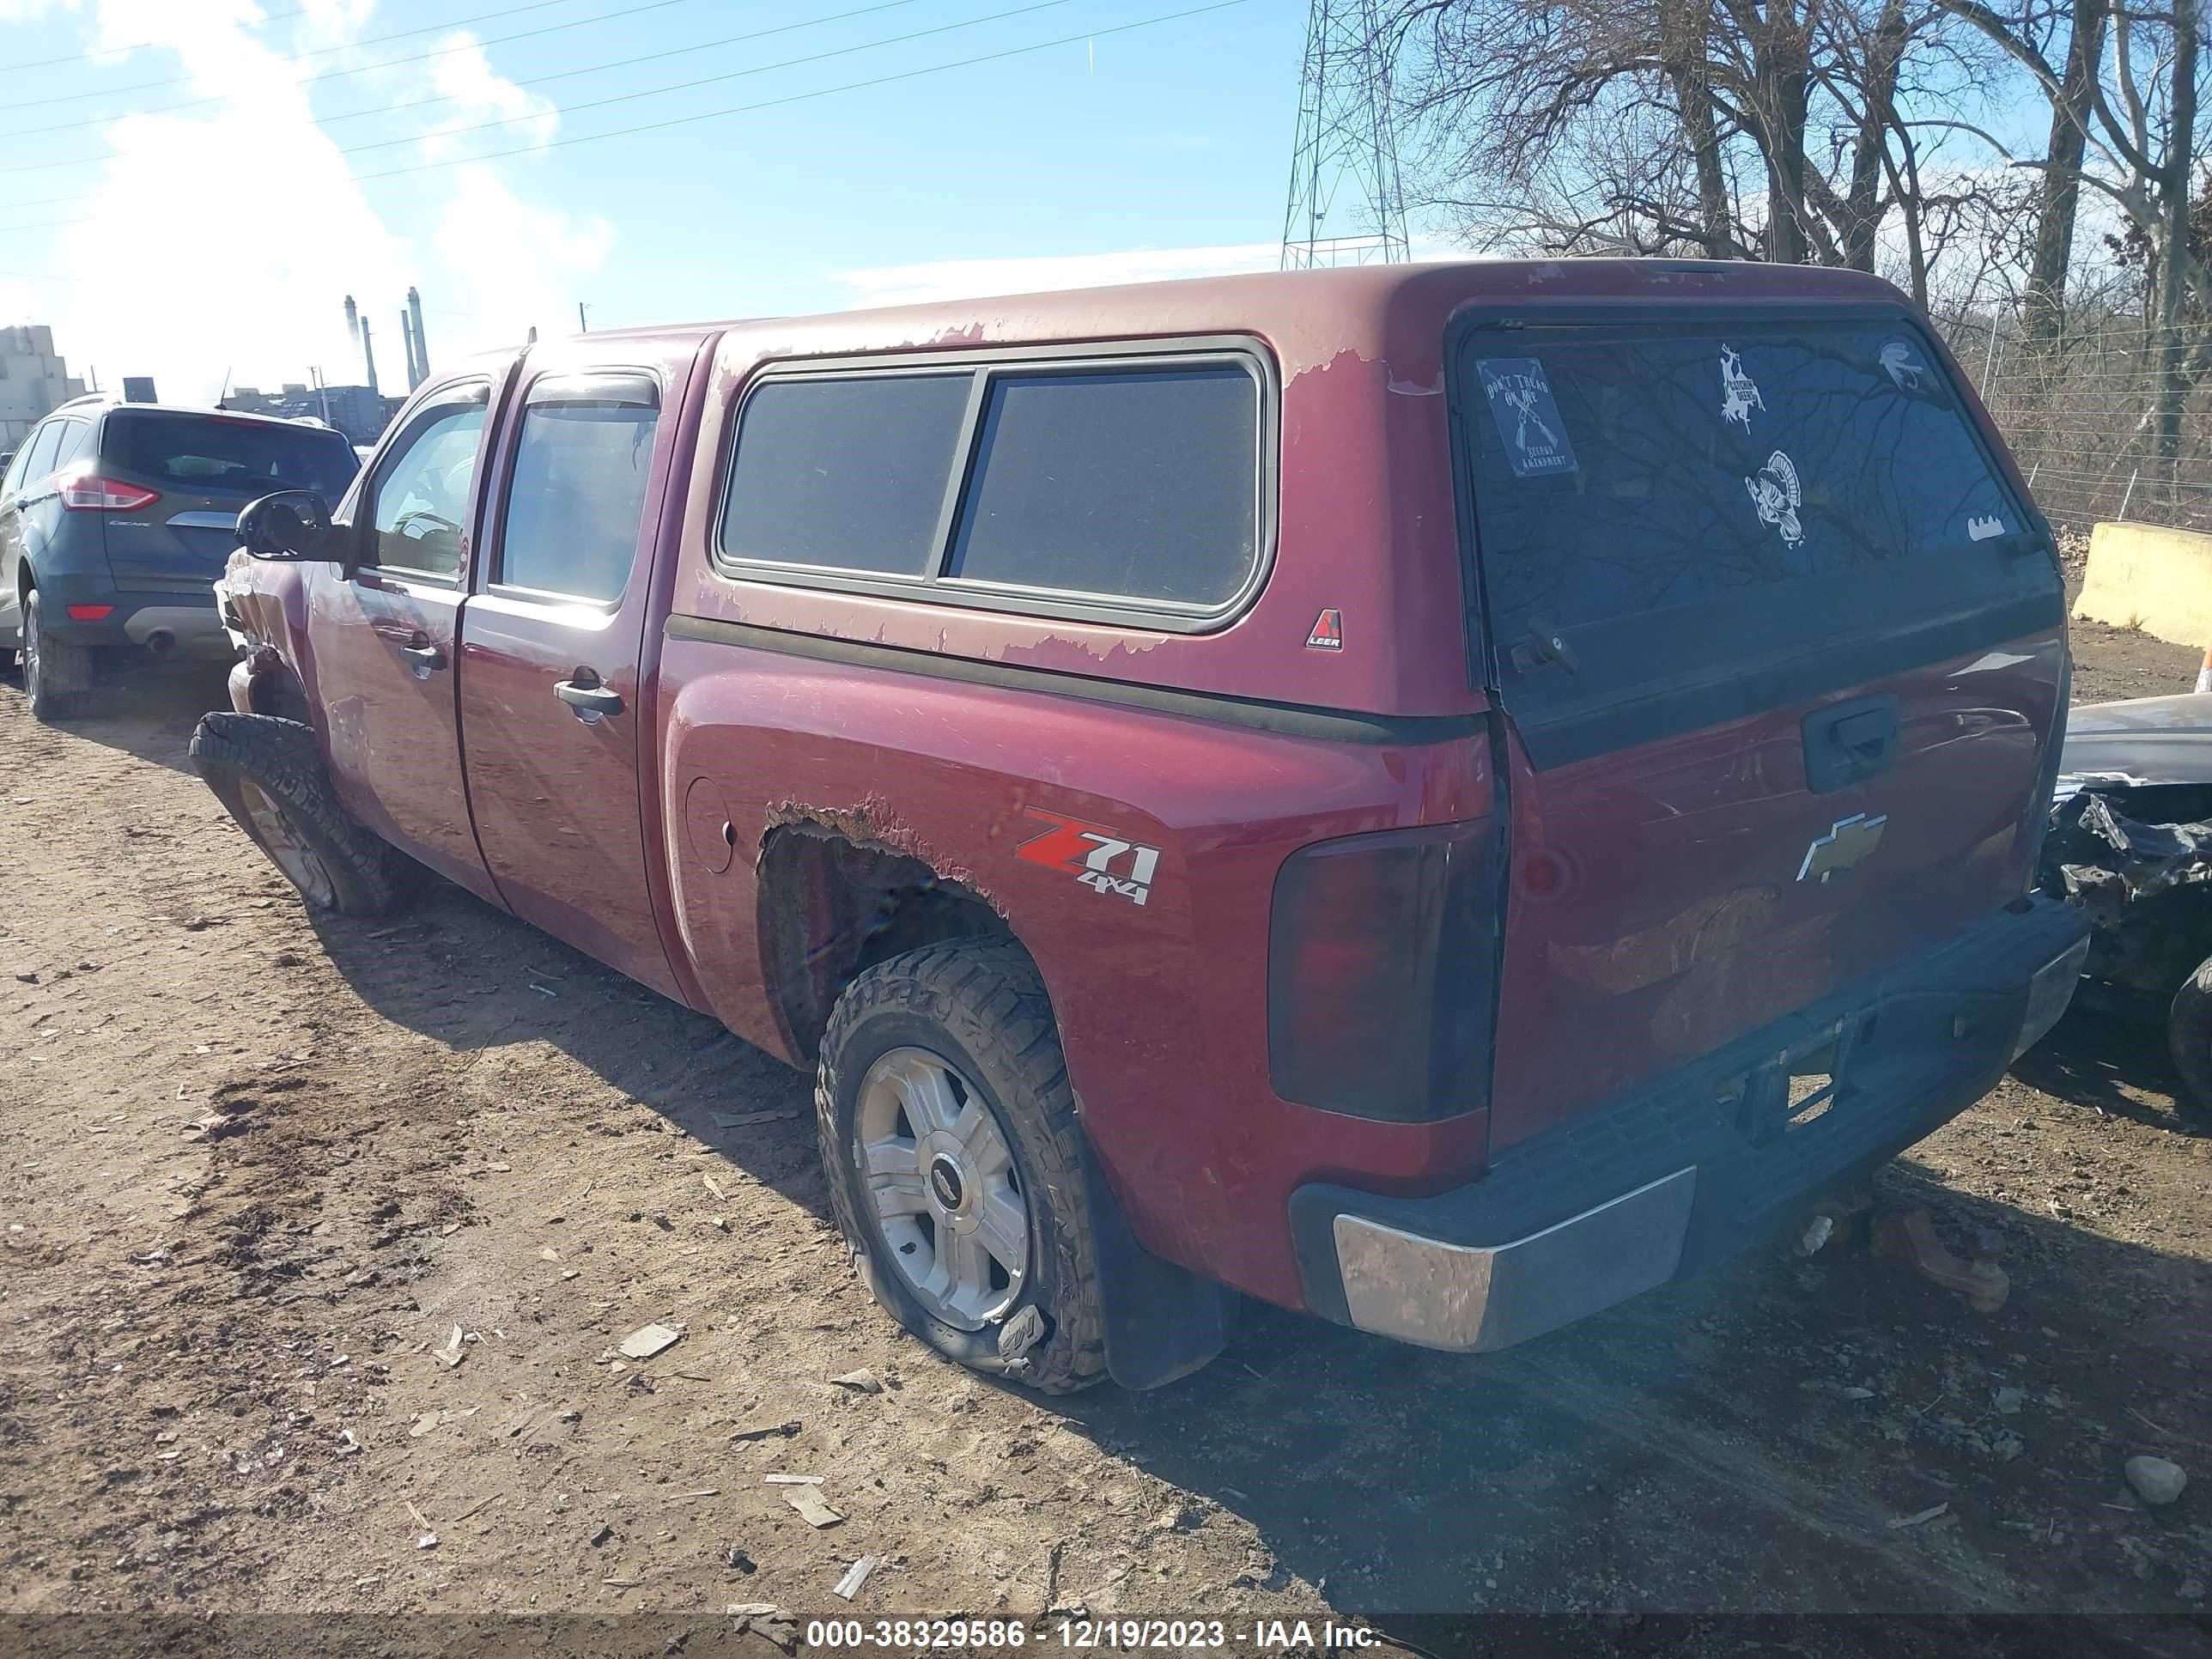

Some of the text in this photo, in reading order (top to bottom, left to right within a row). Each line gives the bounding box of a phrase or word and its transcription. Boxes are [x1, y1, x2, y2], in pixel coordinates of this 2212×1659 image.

[1487, 374, 1548, 398] DON'T TREAD
[1504, 390, 1538, 406] ON ME
[1527, 446, 1553, 459] SECOND
[1522, 456, 1566, 471] AMENDMENT
[1310, 637, 1340, 647] LEER
[1017, 808, 1160, 885] Z71
